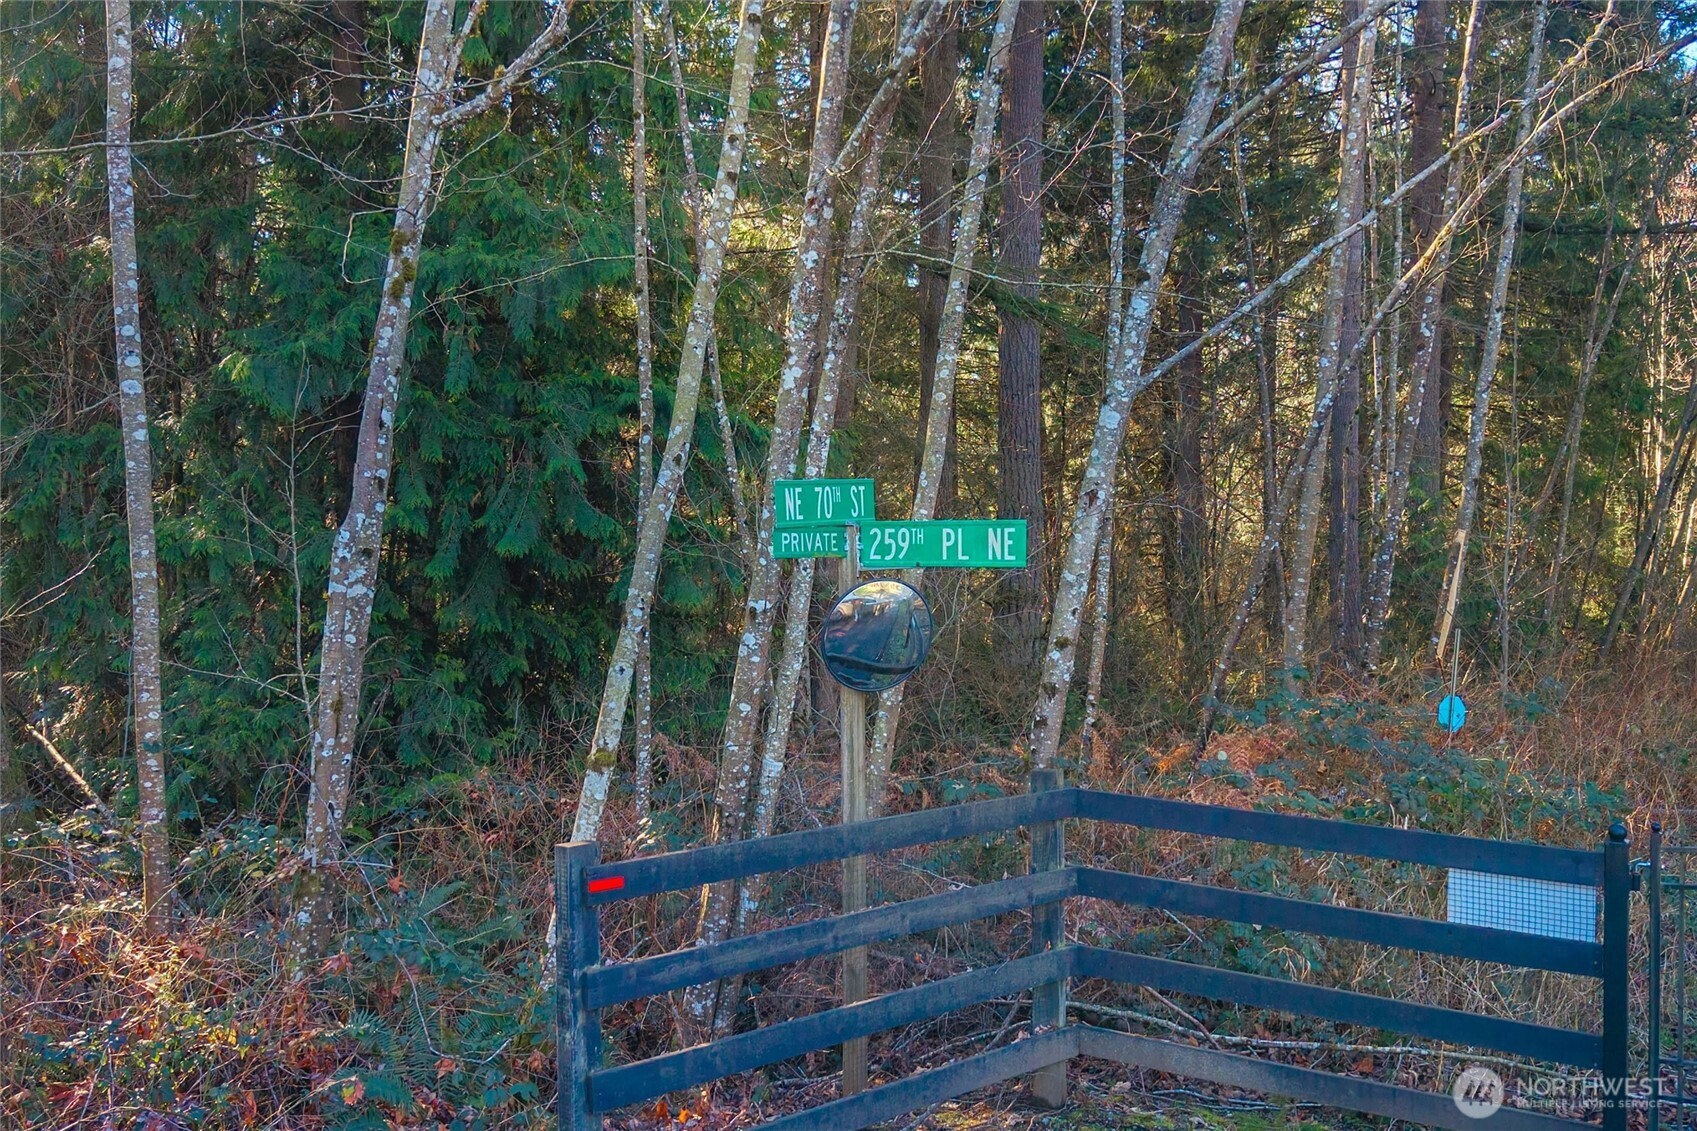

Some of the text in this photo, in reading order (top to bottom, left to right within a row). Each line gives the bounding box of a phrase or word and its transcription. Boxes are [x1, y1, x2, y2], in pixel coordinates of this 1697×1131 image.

[785, 485, 866, 520] NE 70TH ST
[781, 532, 839, 553] PRIVATE
[869, 527, 1016, 560] 259TH PL NE
